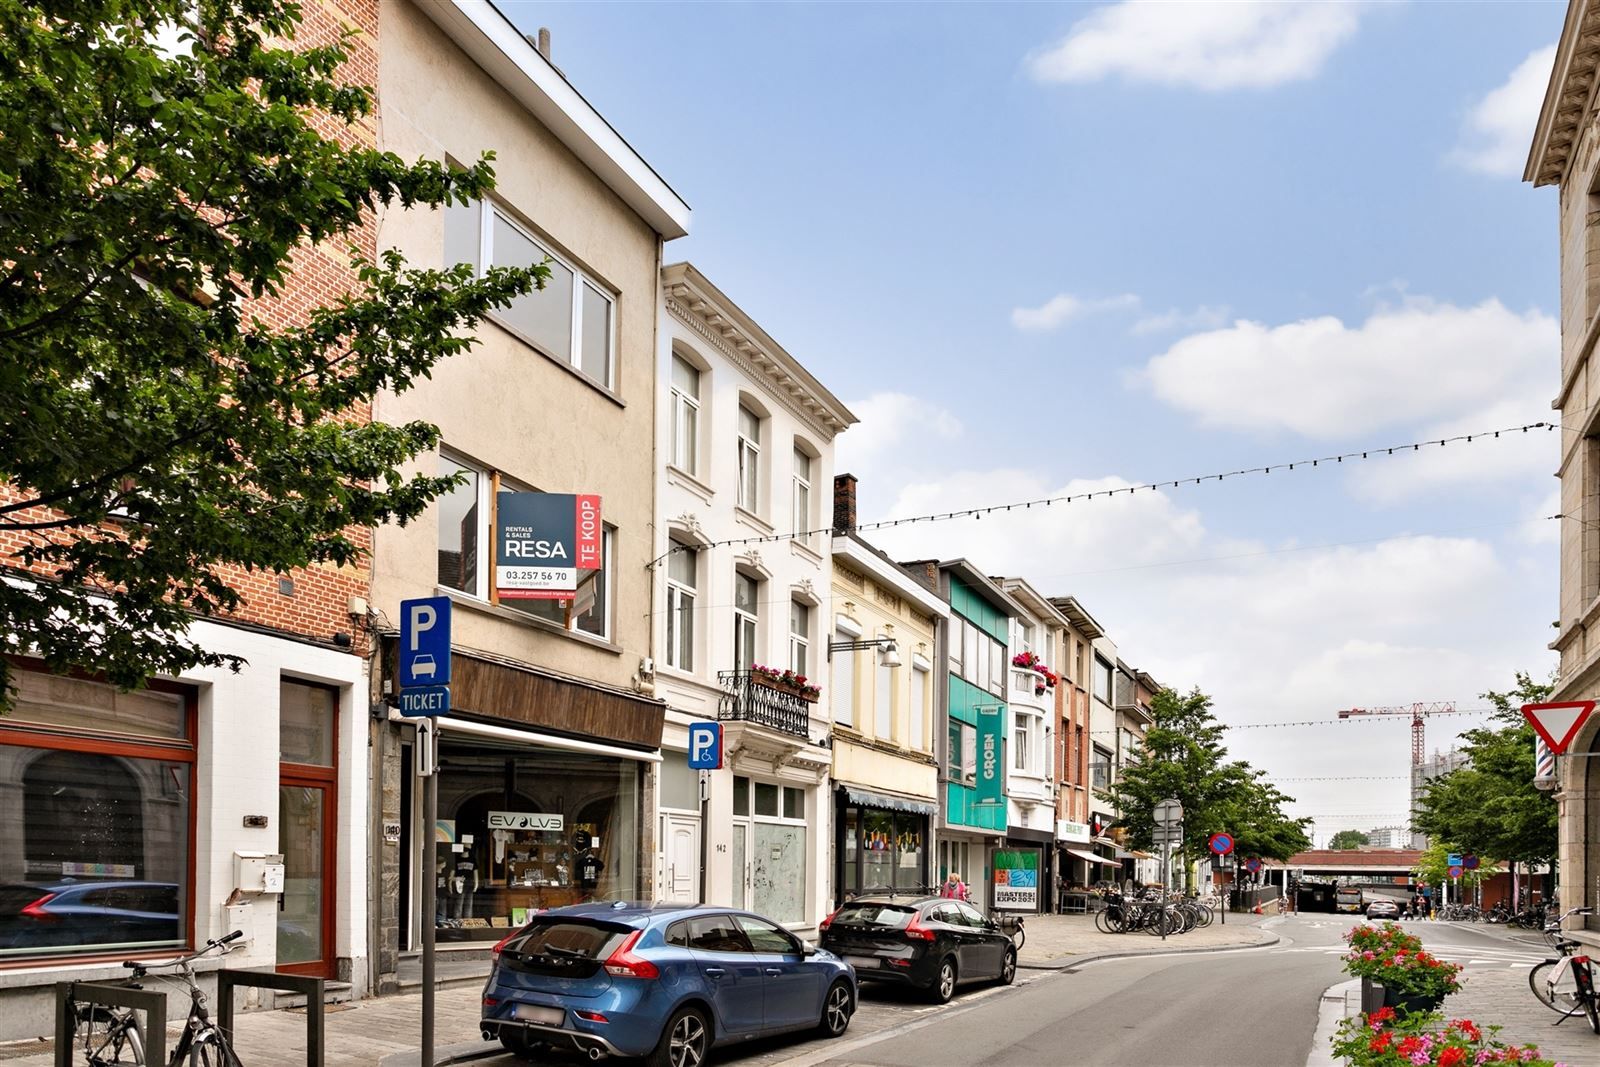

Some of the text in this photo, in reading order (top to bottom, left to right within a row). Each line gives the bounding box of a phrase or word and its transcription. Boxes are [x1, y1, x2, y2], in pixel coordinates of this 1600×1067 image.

[581, 500, 595, 562] TE KOOP
[505, 540, 567, 559] RESA
[506, 571, 567, 581] 03.257 56 70
[411, 605, 437, 651] P
[403, 693, 444, 711] TICKET
[693, 729, 715, 761] P
[983, 733, 996, 780] GROEN
